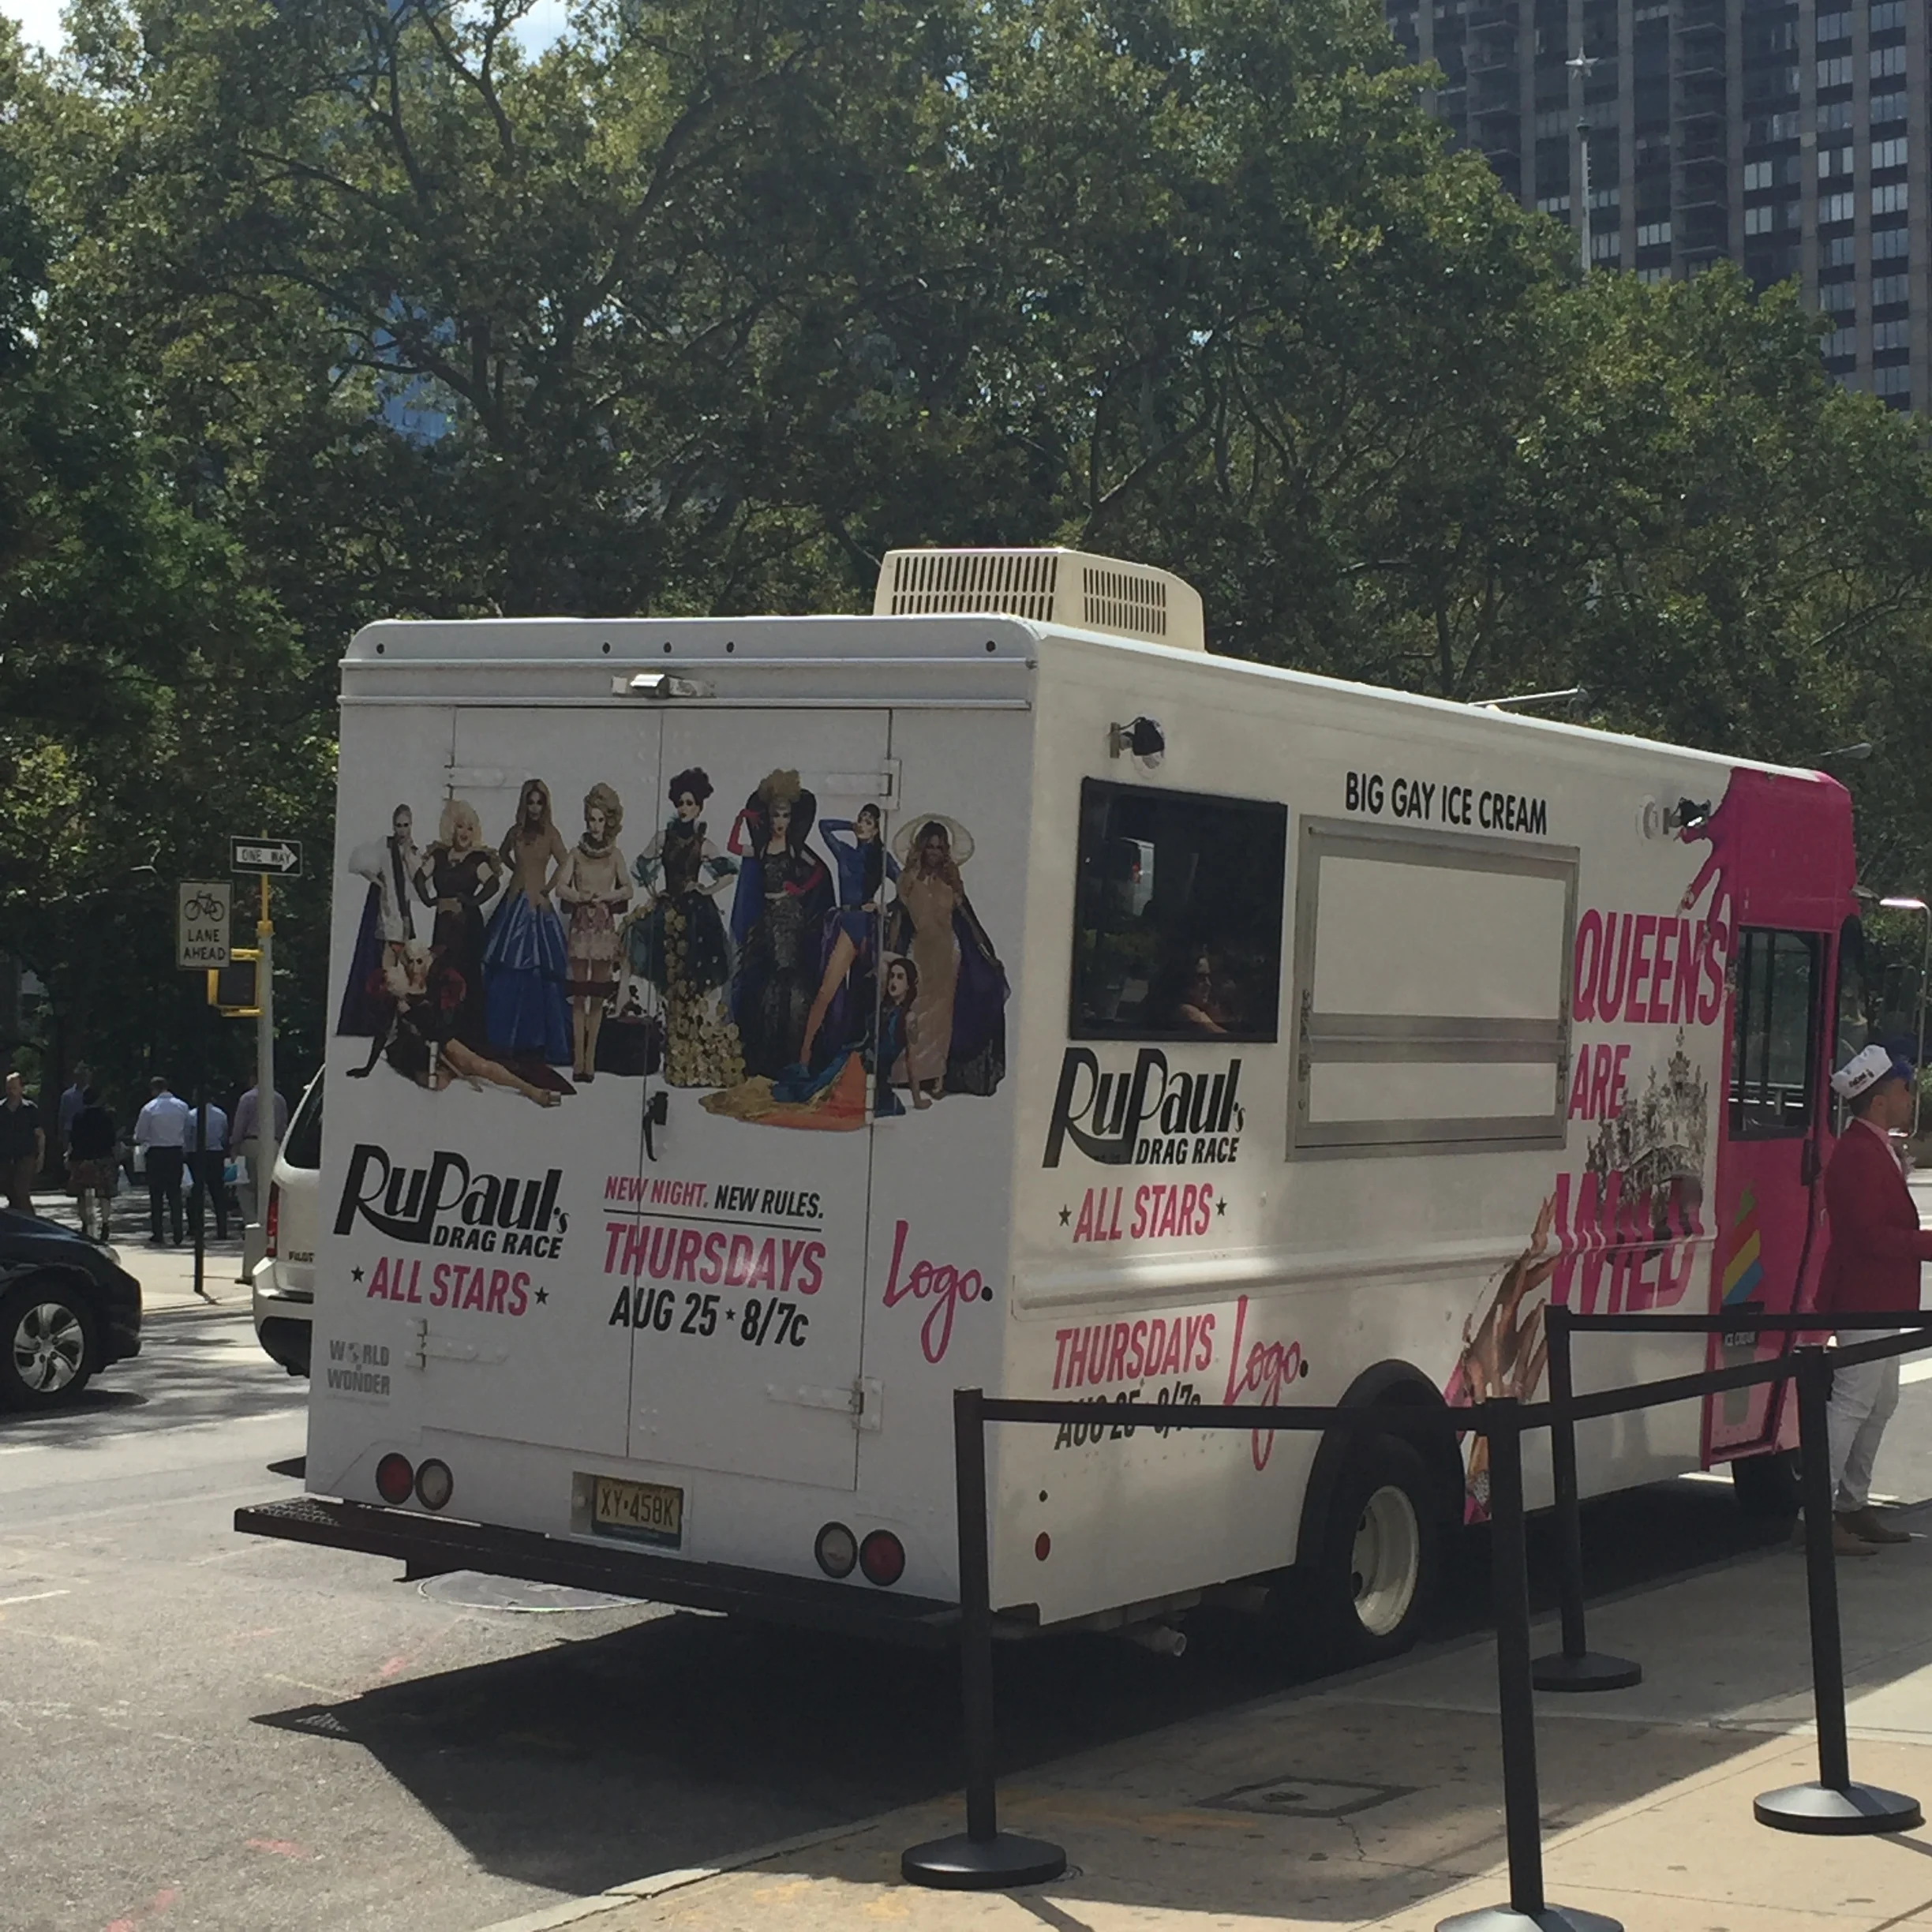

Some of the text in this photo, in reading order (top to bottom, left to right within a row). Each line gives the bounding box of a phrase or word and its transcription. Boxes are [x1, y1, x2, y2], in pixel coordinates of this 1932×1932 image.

[1346, 771, 1547, 835] BIG GAY ICE CREAM
[242, 848, 291, 864] ONE WAY
[183, 947, 226, 961] AHEAD
[188, 929, 220, 942] LANE
[1572, 908, 1729, 1025] QUEENS
[1043, 1046, 1246, 1168] RuPaul's
[1568, 1043, 1631, 1120] ARE
[1135, 1137, 1241, 1166] DRAG RACE
[333, 1143, 569, 1245] RuPaul's
[604, 1175, 824, 1219] NEW NIGHT. NEW RULES.
[1073, 1183, 1214, 1243] ALL STARS
[429, 1225, 563, 1260] DRAG RACE
[604, 1222, 826, 1295] THURSDAYS
[366, 1256, 530, 1316] ALL STARS
[609, 1286, 674, 1331] AUG
[680, 1293, 721, 1336] 25
[1052, 1313, 1215, 1390] THURSDAYS
[328, 1368, 391, 1396] WONDER
